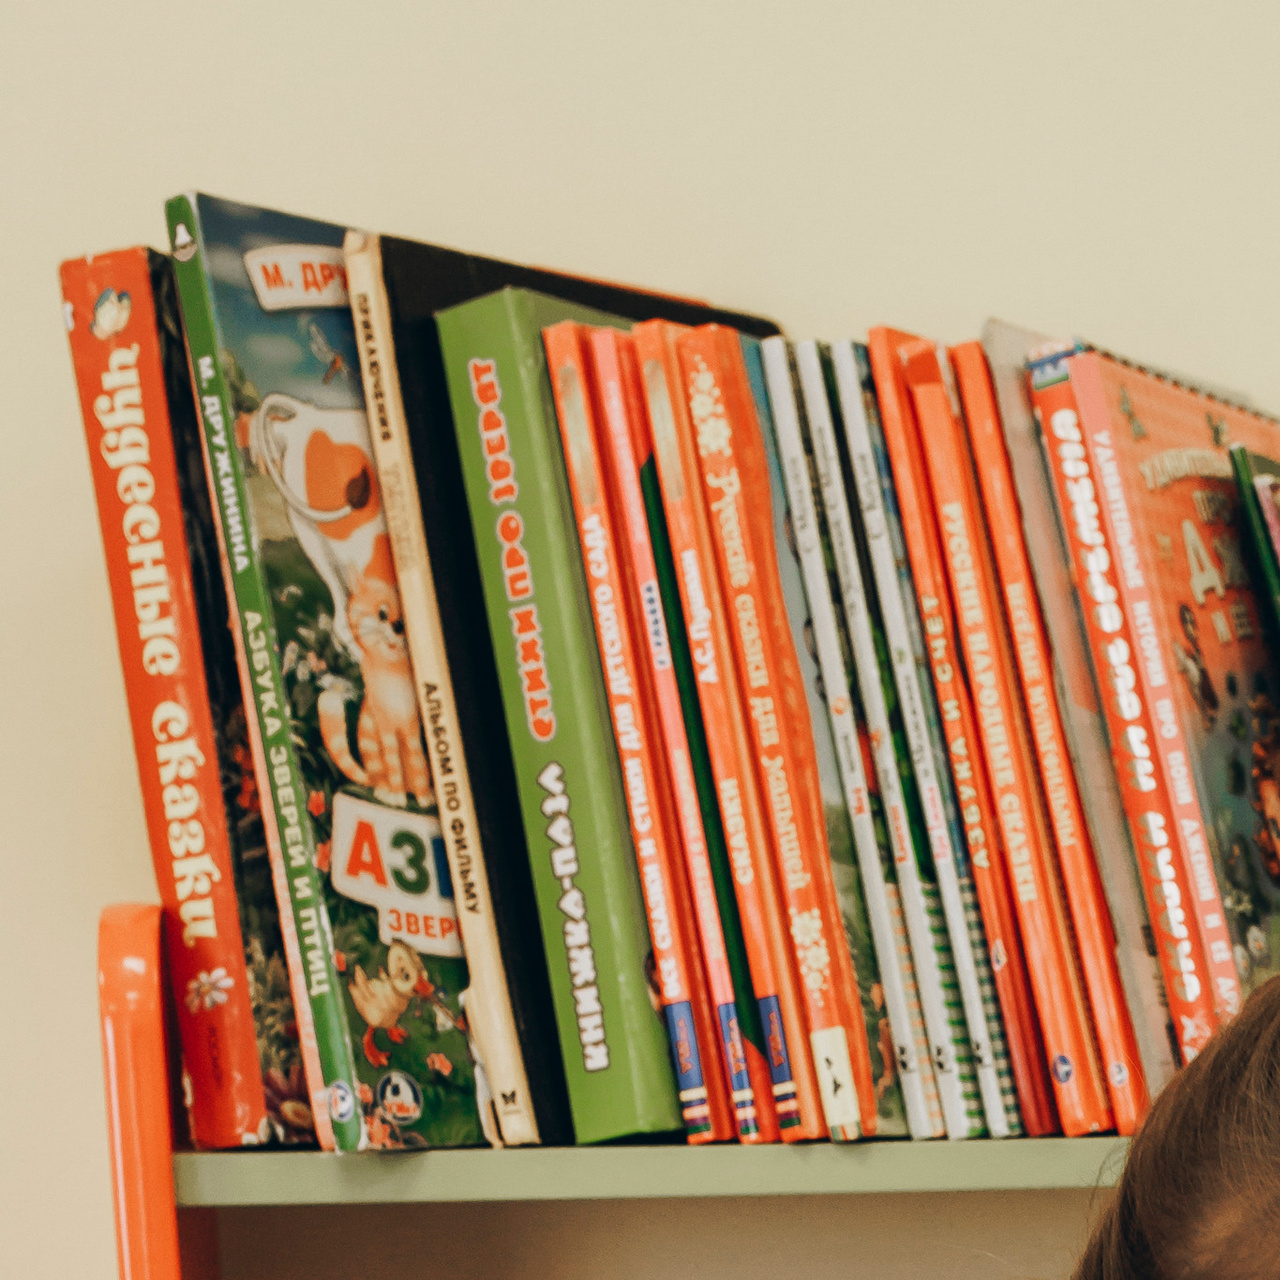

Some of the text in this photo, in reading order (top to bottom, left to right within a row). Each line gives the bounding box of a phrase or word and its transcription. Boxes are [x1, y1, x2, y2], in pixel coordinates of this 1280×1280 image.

[261, 262, 295, 290] М.
[351, 291, 395, 442] ПРИКЛЮЧЕНИЯ
[464, 352, 558, 744] СТИХИ ПРО ЗВЕРЯТ
[580, 511, 612, 578] САДА
[1049, 404, 1125, 637] ВРЕМЕНА
[192, 352, 331, 996] М. ДРУЖИНИНА АЗБУКА ЗВЕРЕЙ И ПТИЦ
[593, 582, 633, 698] ДЕТСКОГО
[1099, 634, 1144, 723] ВСЕ
[1130, 599, 1166, 688] ИСТОРИИ
[1152, 696, 1179, 741] ПРО
[612, 701, 643, 752] ДЛЯ
[921, 590, 993, 870] АЗБУКА И СЧЕТ
[939, 500, 1038, 905] РУССКИЕ НАРОДНЫЕ СКАЗКИ
[1118, 721, 1159, 795] НА
[421, 678, 483, 917] АЛЬБОМ ПО ФИЛЬМУ
[622, 756, 655, 833] СТИХИ
[637, 837, 657, 857] И
[718, 776, 756, 886] СКАЗКИ
[388, 908, 463, 943] ЗВЕР
[531, 758, 612, 1074] КНИЖКА-ПАЗЛ
[641, 860, 675, 951] СКАЗКИ
[1136, 807, 1204, 1006] СКАЗКИ
[657, 954, 684, 998] ВСЕ
